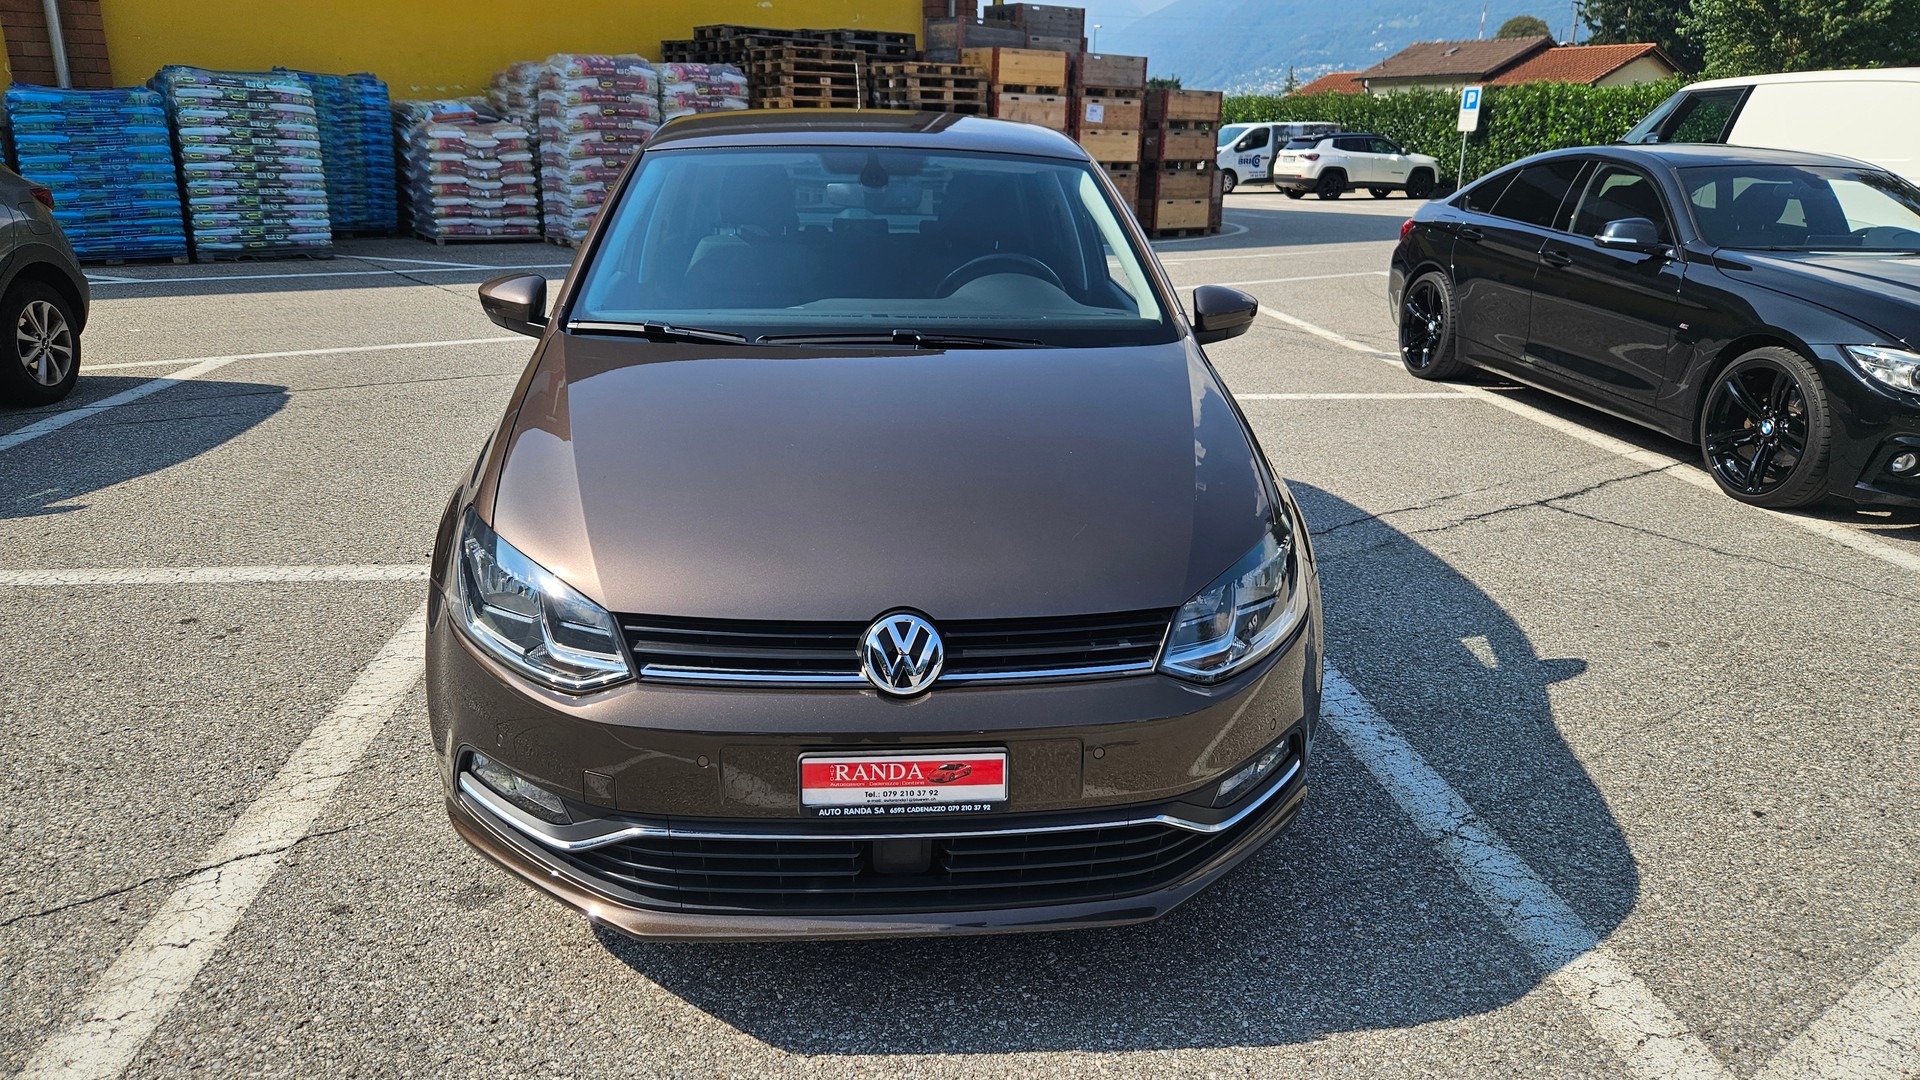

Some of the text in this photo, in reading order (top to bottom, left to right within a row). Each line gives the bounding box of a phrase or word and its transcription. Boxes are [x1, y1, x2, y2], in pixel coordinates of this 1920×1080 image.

[1466, 92, 1476, 108] P
[835, 763, 924, 781] RANDA
[907, 805, 946, 813] CADENAZZO
